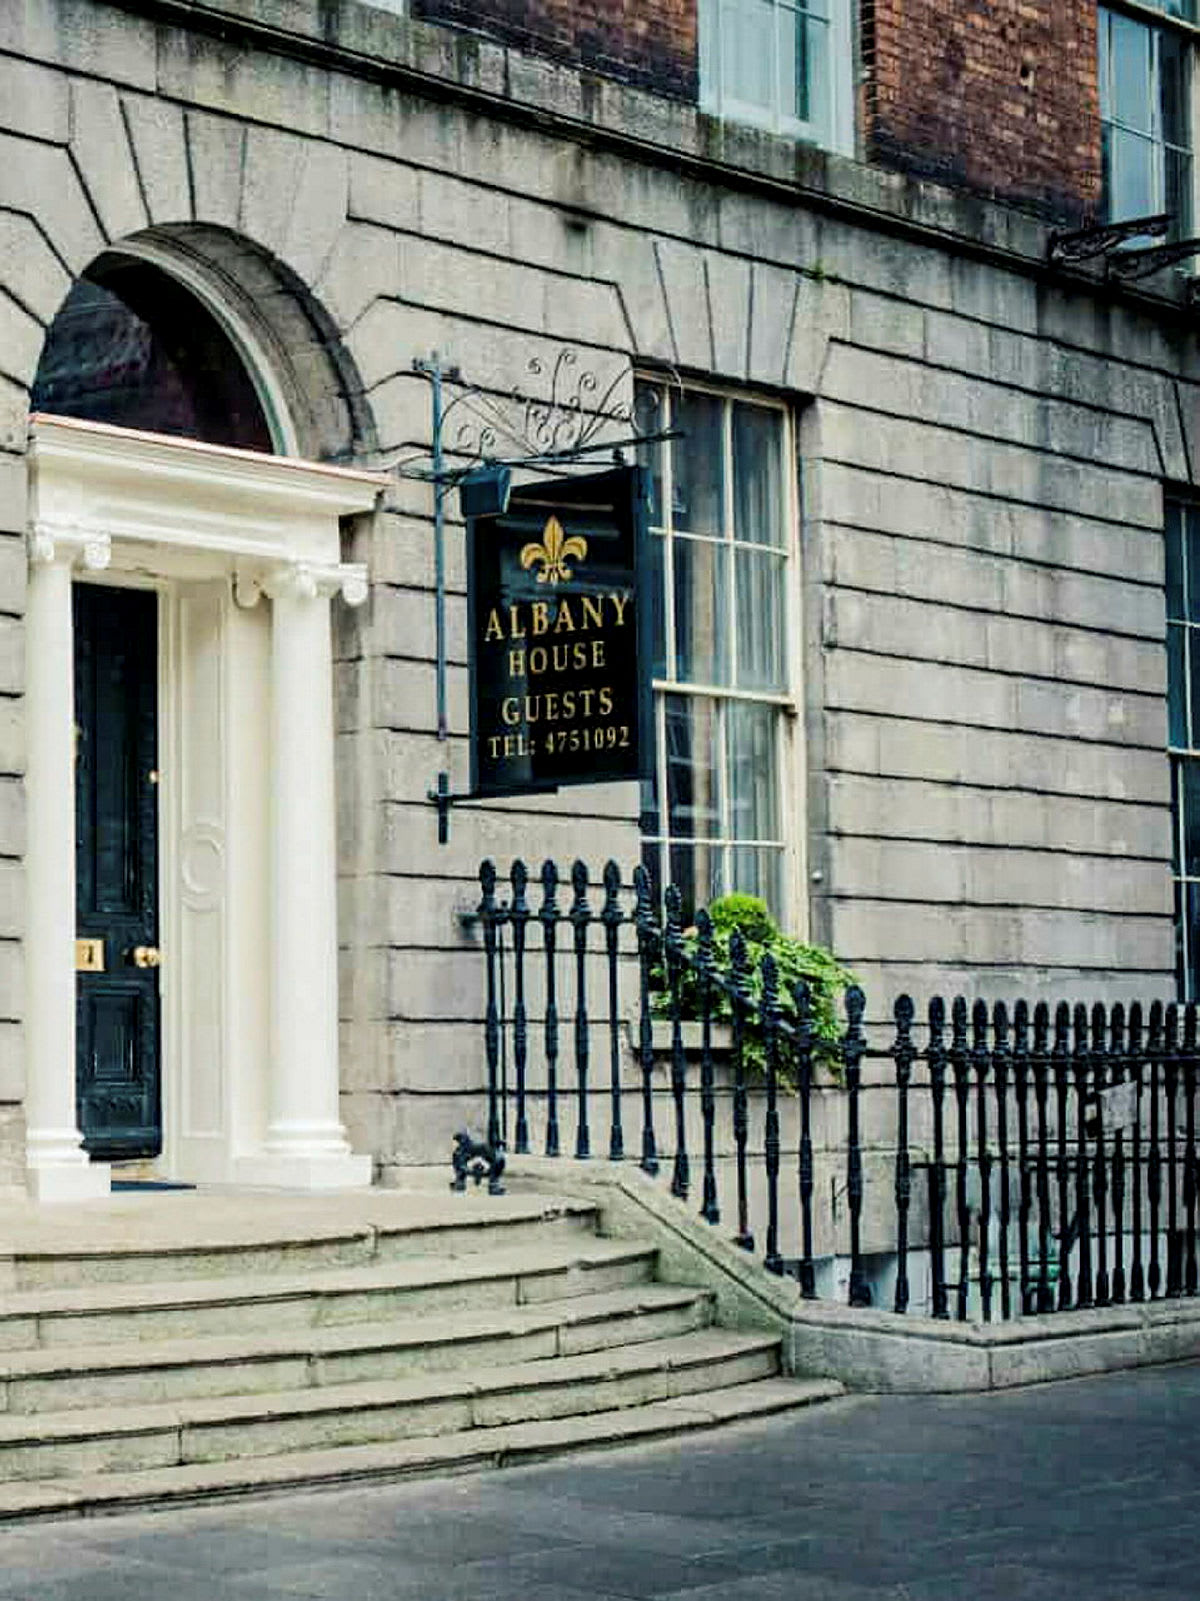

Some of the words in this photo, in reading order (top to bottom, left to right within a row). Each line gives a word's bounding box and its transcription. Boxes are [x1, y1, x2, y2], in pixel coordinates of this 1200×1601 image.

[485, 592, 630, 642] ALBANY
[509, 641, 606, 677] HOUSE
[502, 687, 614, 725] GUESTS
[489, 735, 536, 758] TEL:
[545, 726, 631, 754] 4751092
